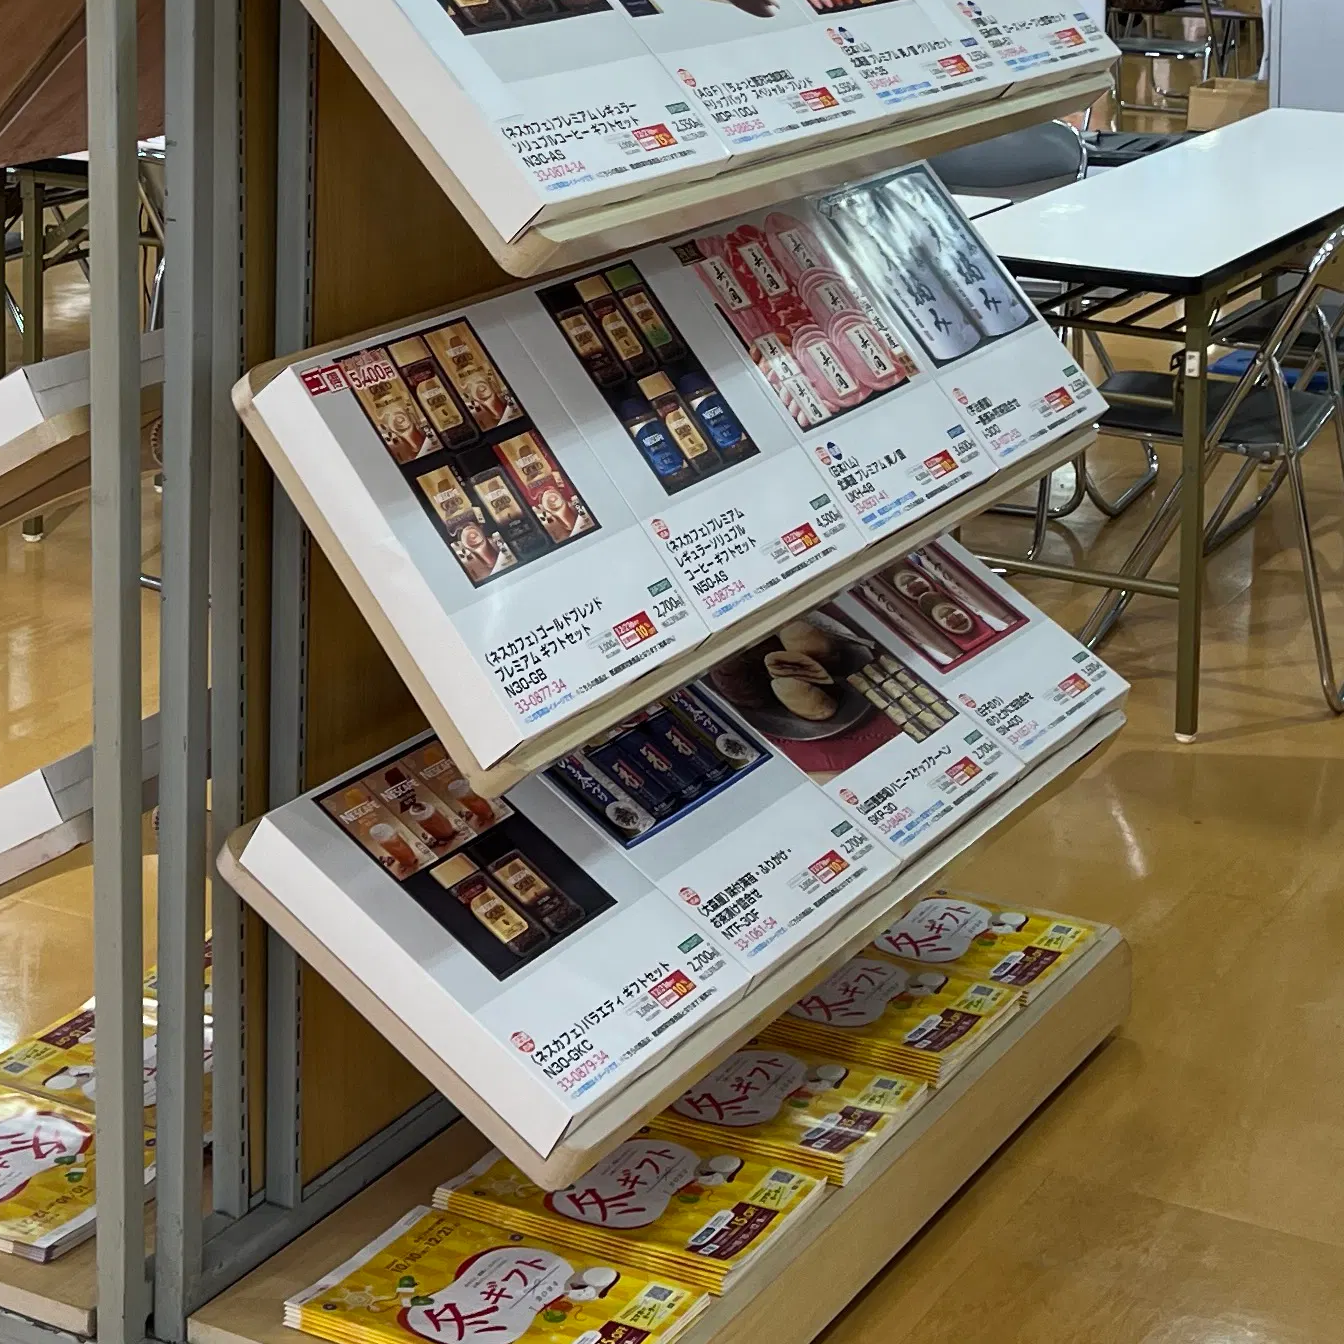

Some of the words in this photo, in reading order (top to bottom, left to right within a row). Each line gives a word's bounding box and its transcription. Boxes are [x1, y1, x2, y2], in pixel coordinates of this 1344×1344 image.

[691, 569, 729, 595] N50-AS
[494, 649, 541, 682] プレミアム
[538, 622, 593, 659] ギフトセット
[504, 667, 547, 698] N30-GB
[620, 958, 672, 1000] ギフトセット
[543, 1038, 595, 1078] N30-GKC
